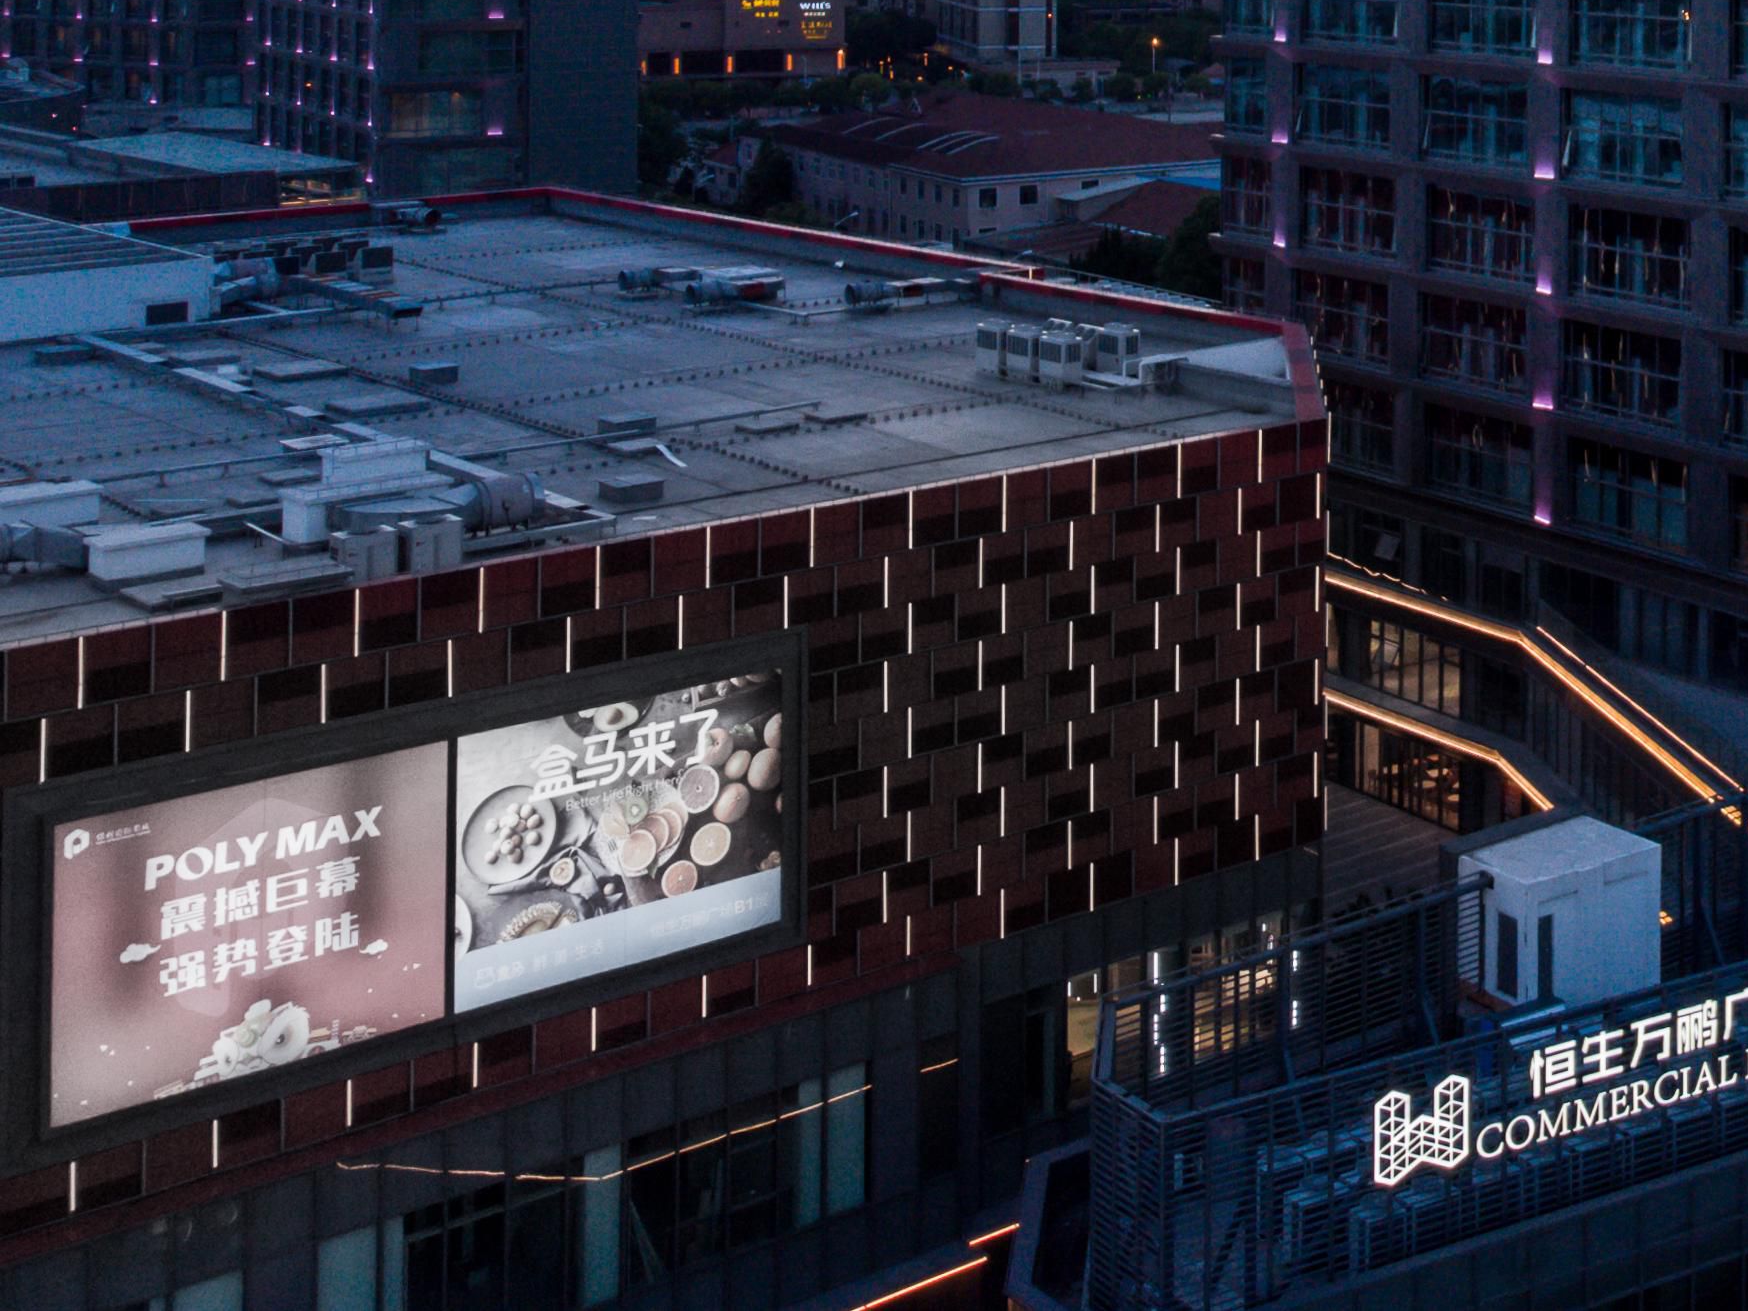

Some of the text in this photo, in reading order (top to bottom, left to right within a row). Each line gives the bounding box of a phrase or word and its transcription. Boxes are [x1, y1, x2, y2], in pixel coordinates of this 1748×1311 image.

[528, 708, 719, 803] 盒马来了
[566, 793, 600, 813] Better
[603, 787, 624, 803] Life
[625, 780, 653, 798] Right
[144, 805, 383, 891] POLY MAX
[160, 856, 361, 940] 震撼巨幕
[159, 912, 359, 997] 强势登陆
[1475, 1054, 1738, 1159] COMMERCIAL
